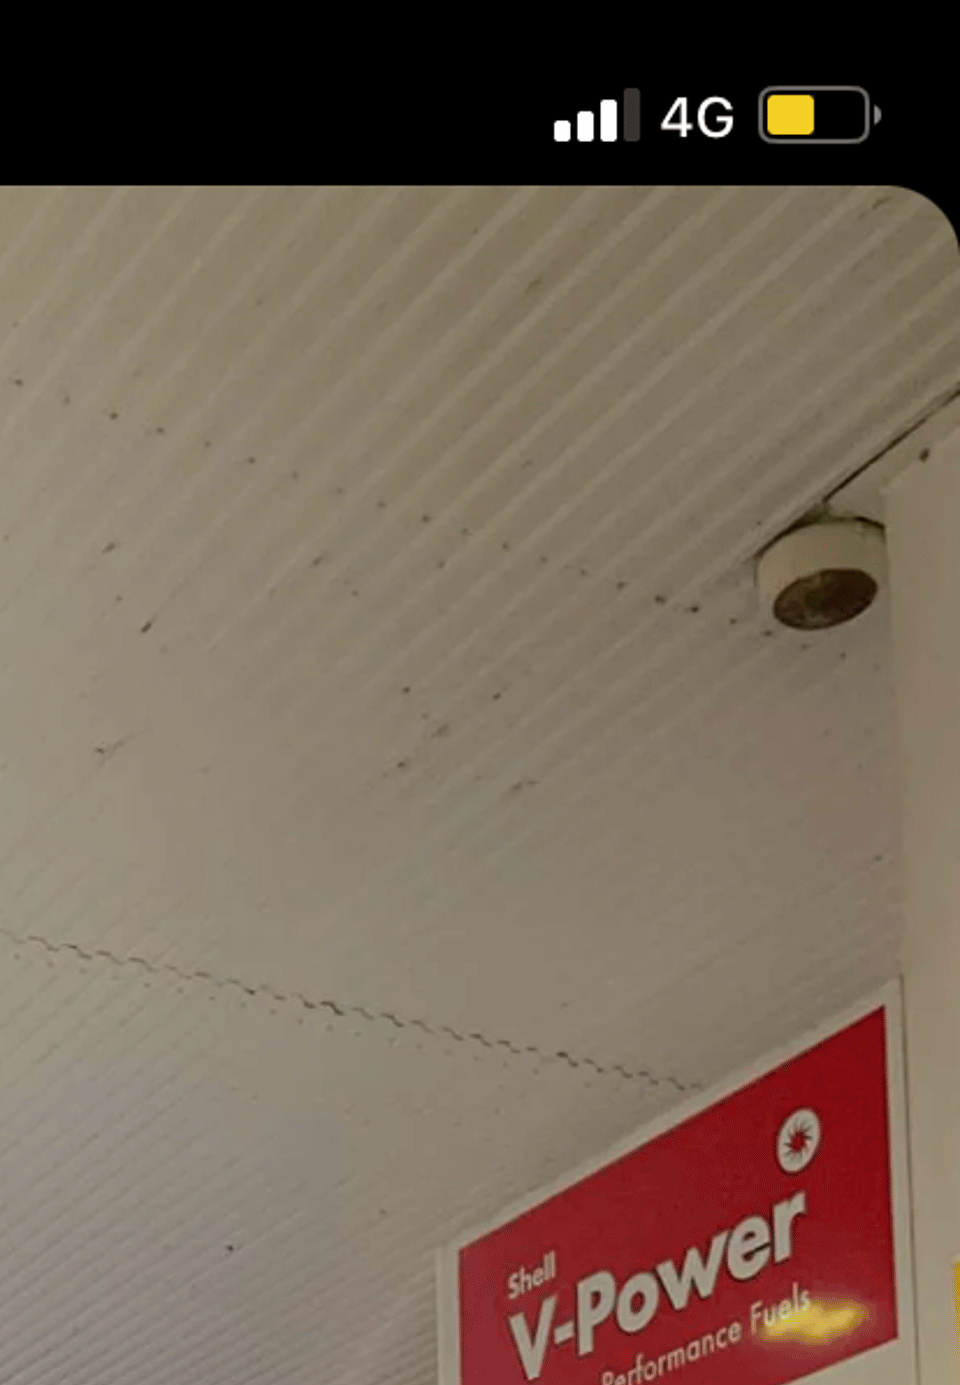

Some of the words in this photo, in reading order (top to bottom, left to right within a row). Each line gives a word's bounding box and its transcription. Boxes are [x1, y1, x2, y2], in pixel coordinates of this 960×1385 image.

[508, 1250, 557, 1299] Shell
[508, 1190, 807, 1381] V-Power
[750, 1281, 810, 1335] Fuels
